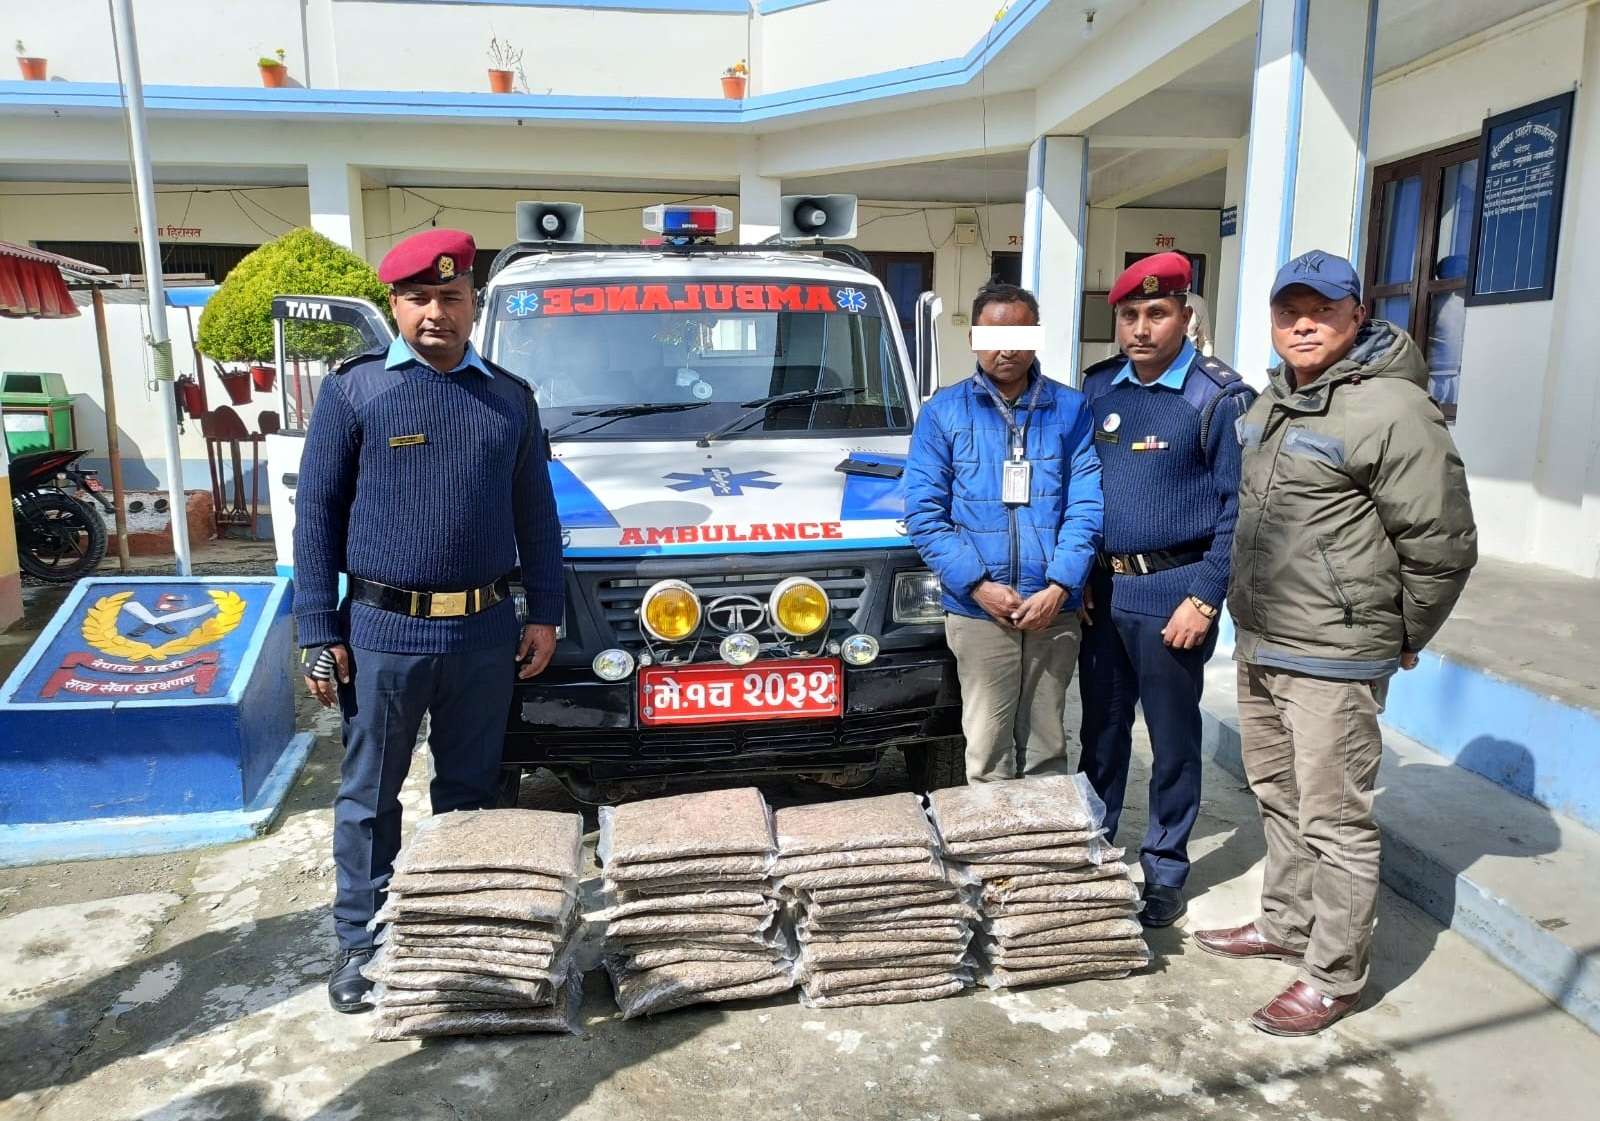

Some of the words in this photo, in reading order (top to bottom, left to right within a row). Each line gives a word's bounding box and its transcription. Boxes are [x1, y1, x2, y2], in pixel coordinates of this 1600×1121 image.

[286, 301, 332, 320] TATA
[619, 521, 844, 546] AMBULANCE
[91, 659, 139, 672] नेपाल
[143, 659, 185, 673] प्रहरी
[65, 678, 97, 692] सत्य
[100, 681, 131, 693] सेवा
[743, 671, 832, 708] २०३२
